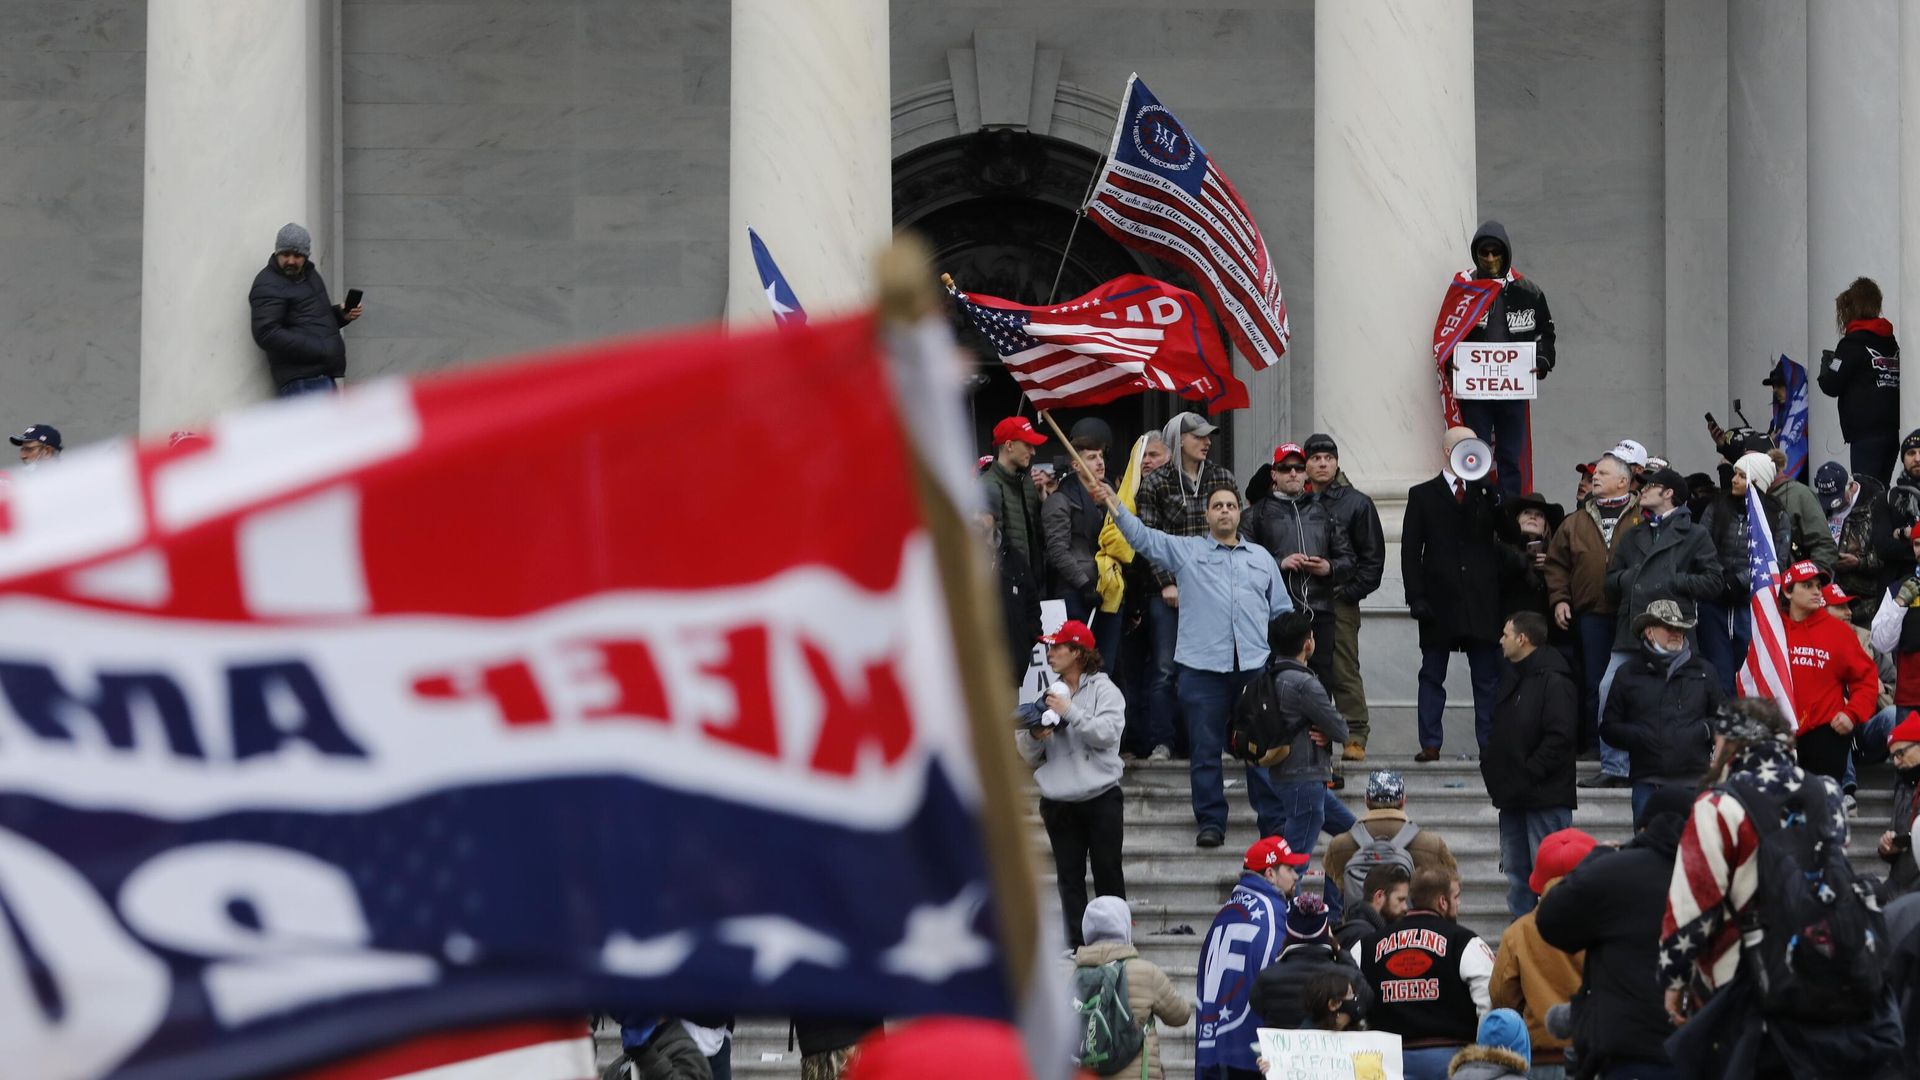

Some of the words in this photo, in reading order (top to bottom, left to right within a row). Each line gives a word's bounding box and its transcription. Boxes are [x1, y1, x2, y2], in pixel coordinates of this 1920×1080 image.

[1153, 134, 1174, 153] 1776
[1115, 165, 1160, 186] ammunition
[1161, 181, 1171, 191] to
[1172, 188, 1208, 218] maintain
[1105, 187, 1124, 200] any
[1125, 196, 1141, 206] who
[1165, 209, 1201, 236] Attempt
[1208, 242, 1228, 265] abuse
[1148, 232, 1167, 242] own
[1235, 304, 1269, 353] Washington
[1470, 350, 1518, 363] STOP
[1480, 364, 1509, 376] THE
[1465, 378, 1524, 391] STEAL
[1792, 656, 1825, 669] AGAN
[1265, 851, 1278, 864] 45
[1375, 928, 1447, 963] PAWLING
[1380, 978, 1439, 1003] TIGERS
